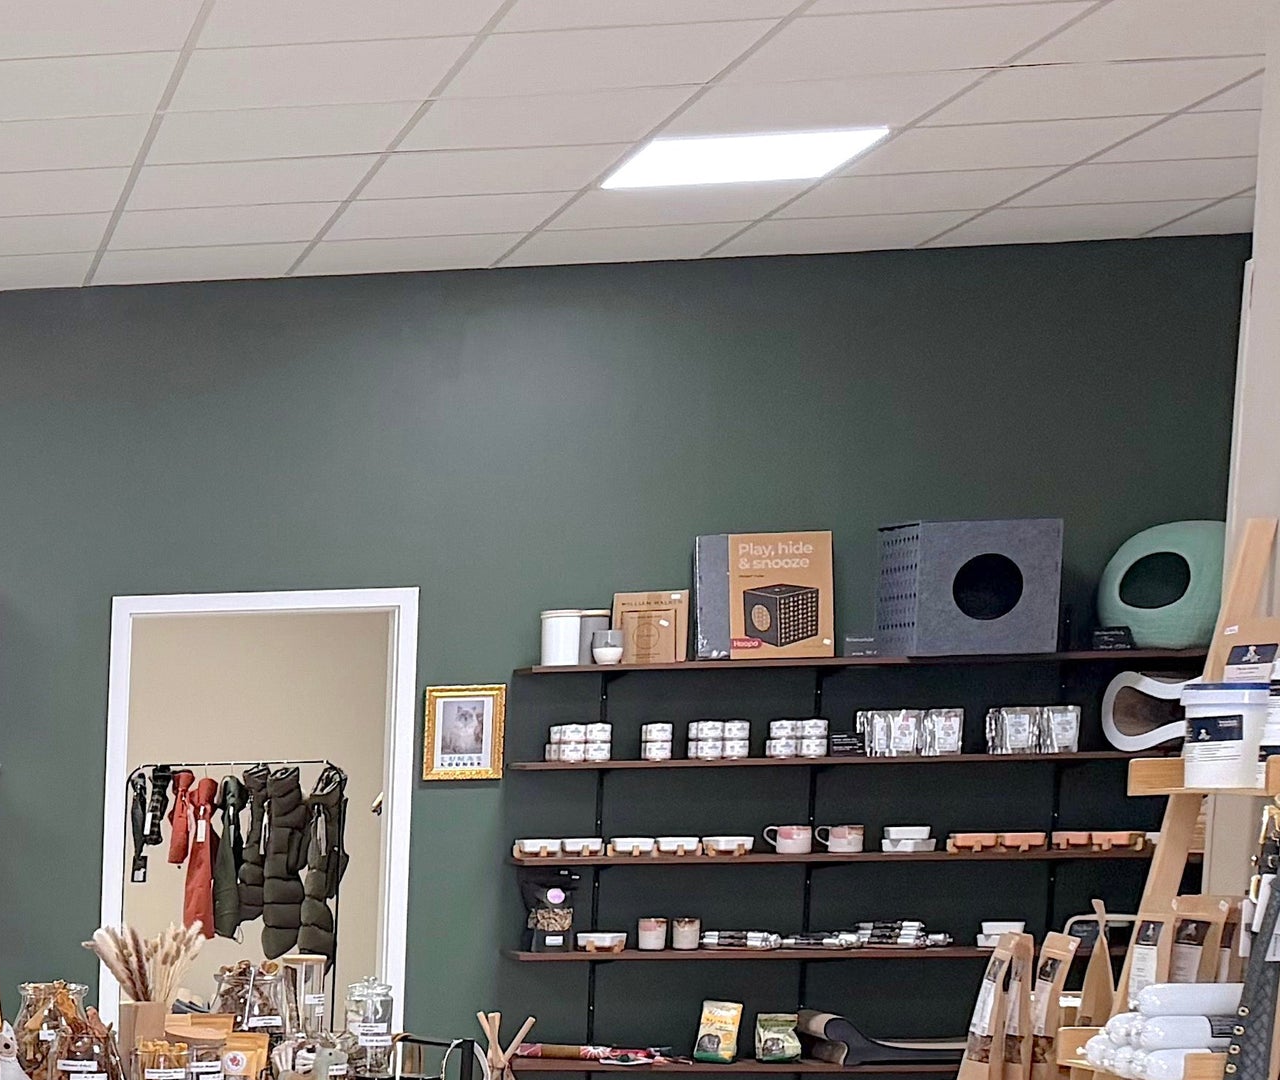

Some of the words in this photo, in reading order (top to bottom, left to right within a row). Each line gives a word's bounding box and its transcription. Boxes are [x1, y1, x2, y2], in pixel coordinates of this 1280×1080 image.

[738, 542, 775, 557] Play,
[778, 541, 813, 554] hide
[738, 557, 751, 570] &
[752, 557, 810, 569] snooze
[733, 640, 759, 648] Hoopo
